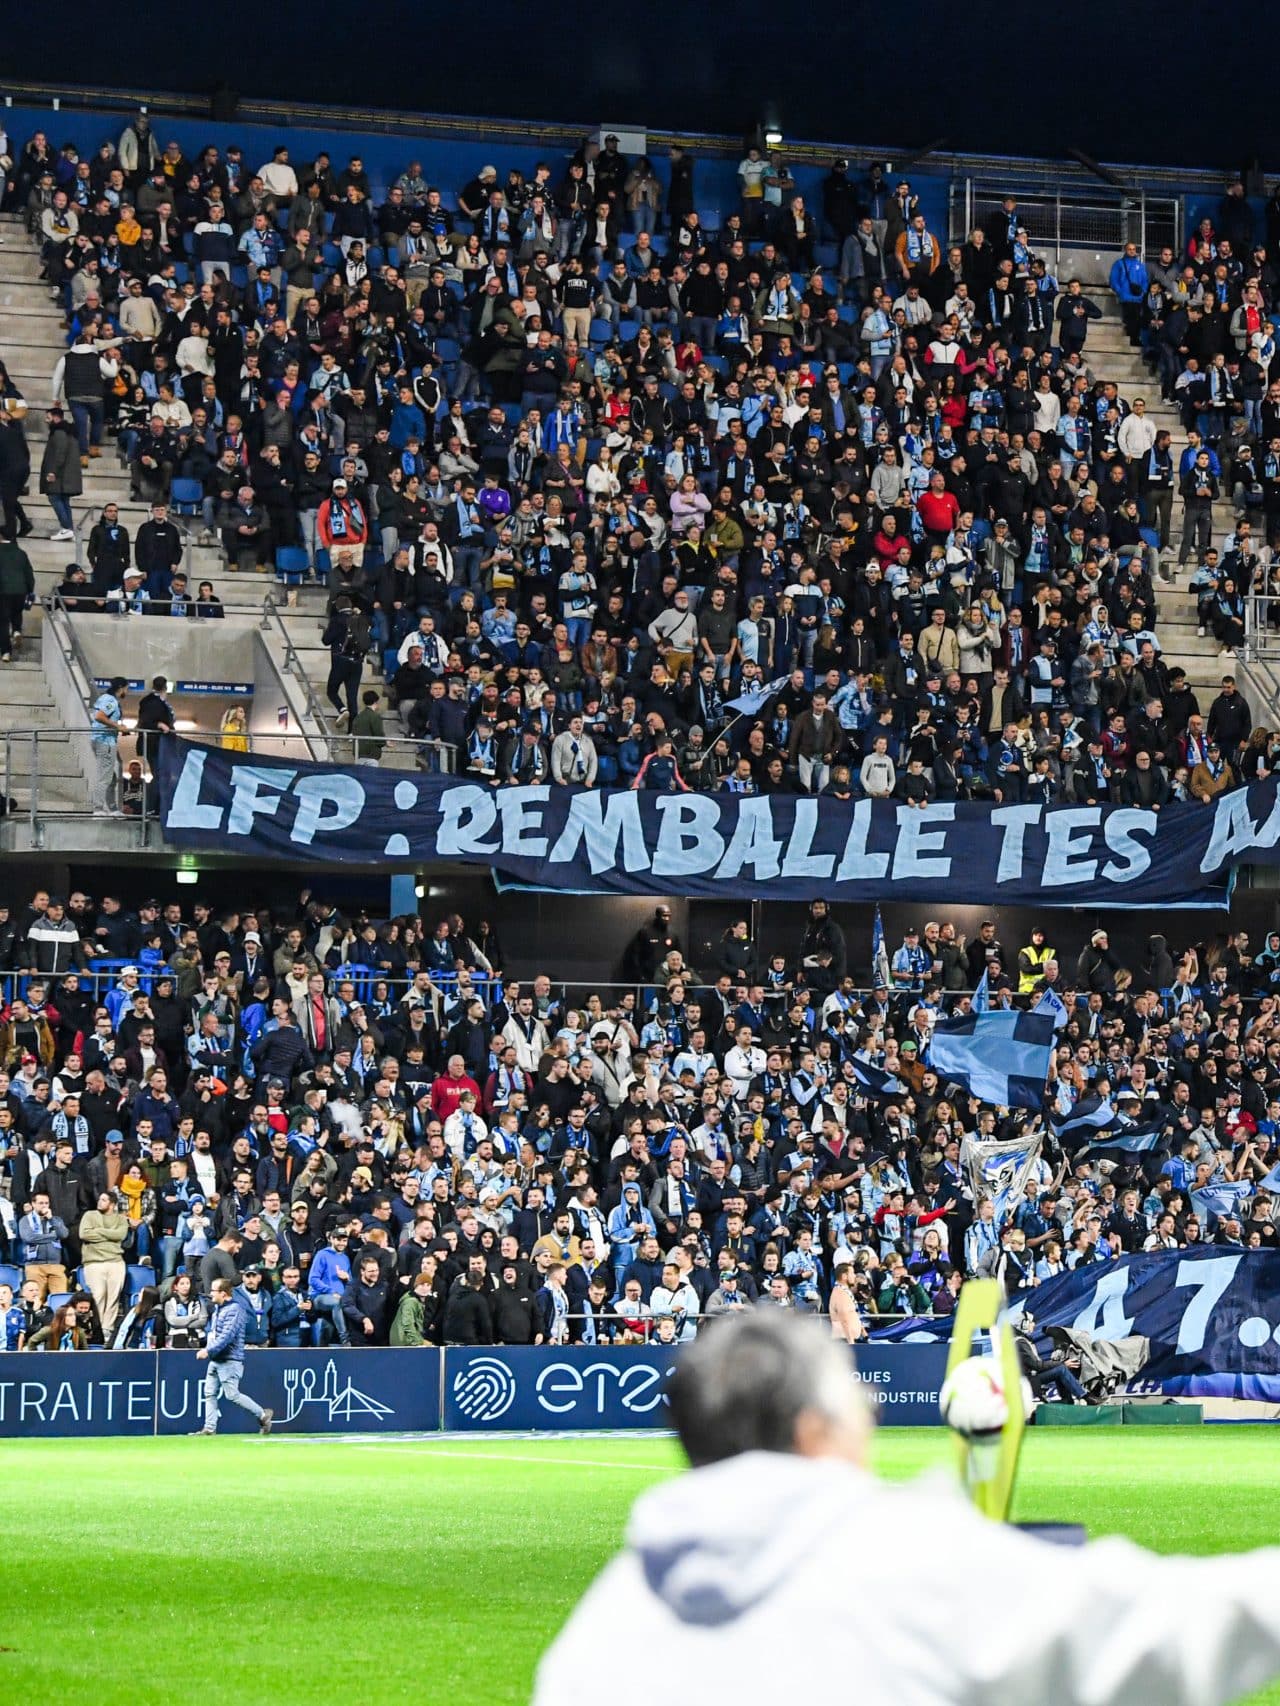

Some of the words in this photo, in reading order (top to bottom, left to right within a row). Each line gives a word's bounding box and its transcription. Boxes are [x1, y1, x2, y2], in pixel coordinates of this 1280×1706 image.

[166, 749, 366, 845] LFP
[436, 784, 956, 882] REMBALLE
[990, 803, 1158, 887] TES
